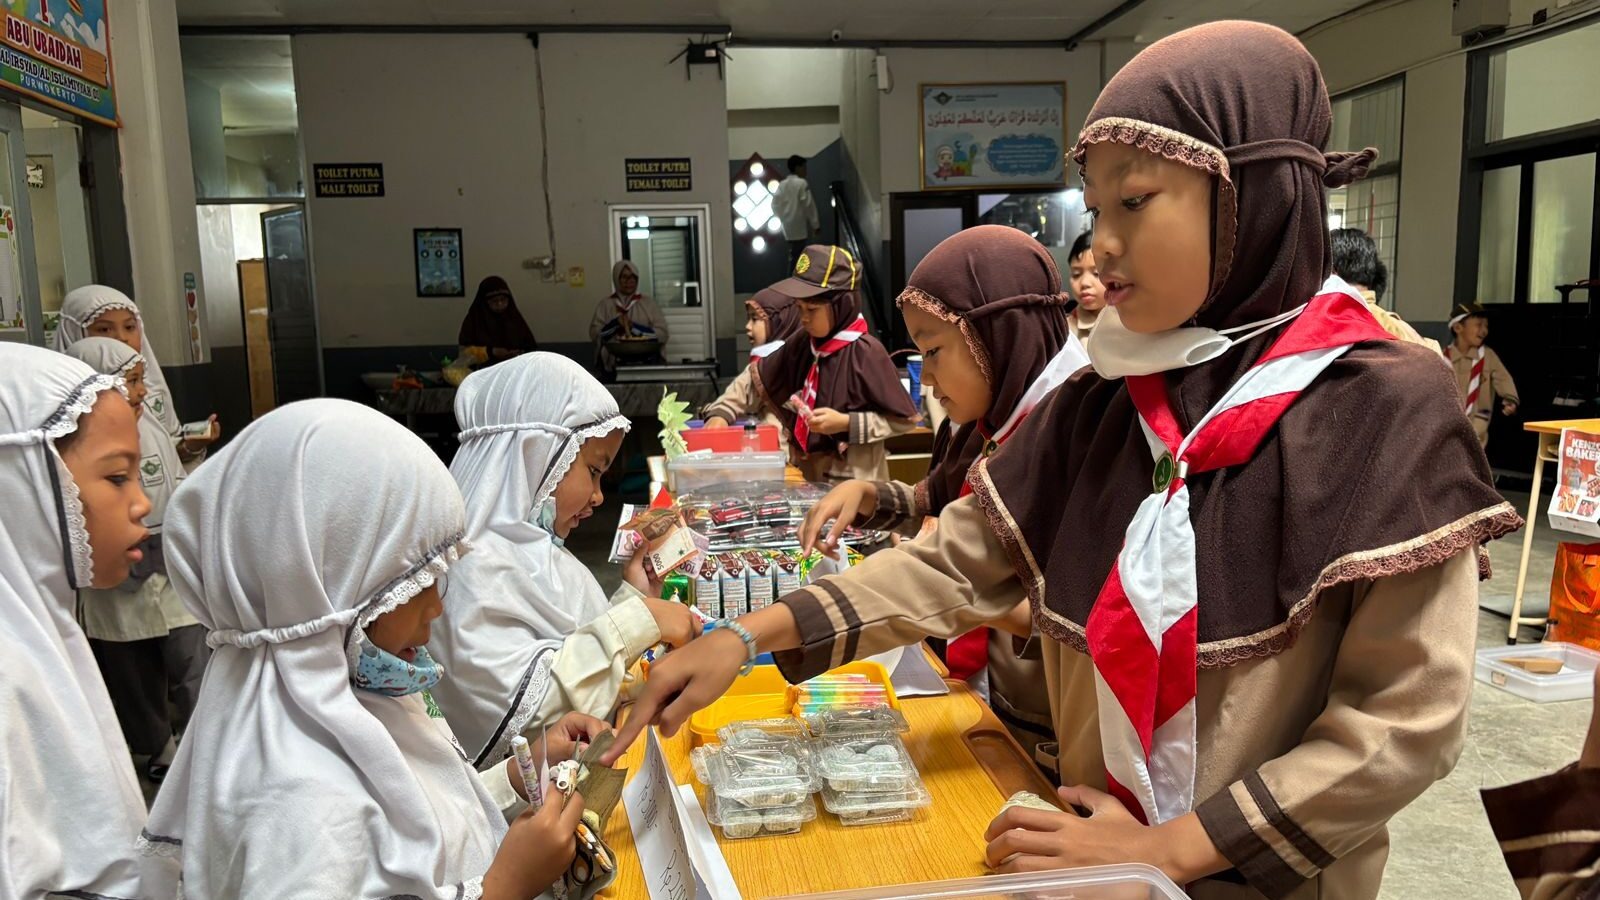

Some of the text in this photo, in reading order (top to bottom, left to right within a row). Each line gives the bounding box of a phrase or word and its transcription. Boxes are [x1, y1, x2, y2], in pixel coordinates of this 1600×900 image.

[6, 15, 82, 71] ABU UBAIDAH
[0, 48, 11, 65] AL
[10, 52, 39, 77] IRSYAD
[39, 65, 50, 82] AL
[20, 74, 76, 103] PURWOKERTO
[317, 168, 380, 178] TOILET PUTRA
[627, 162, 689, 173] TOILET PUTRI
[320, 184, 379, 194] MALE TOILET
[628, 179, 689, 189] FEMALE TOILET
[658, 849, 677, 896] Rp
